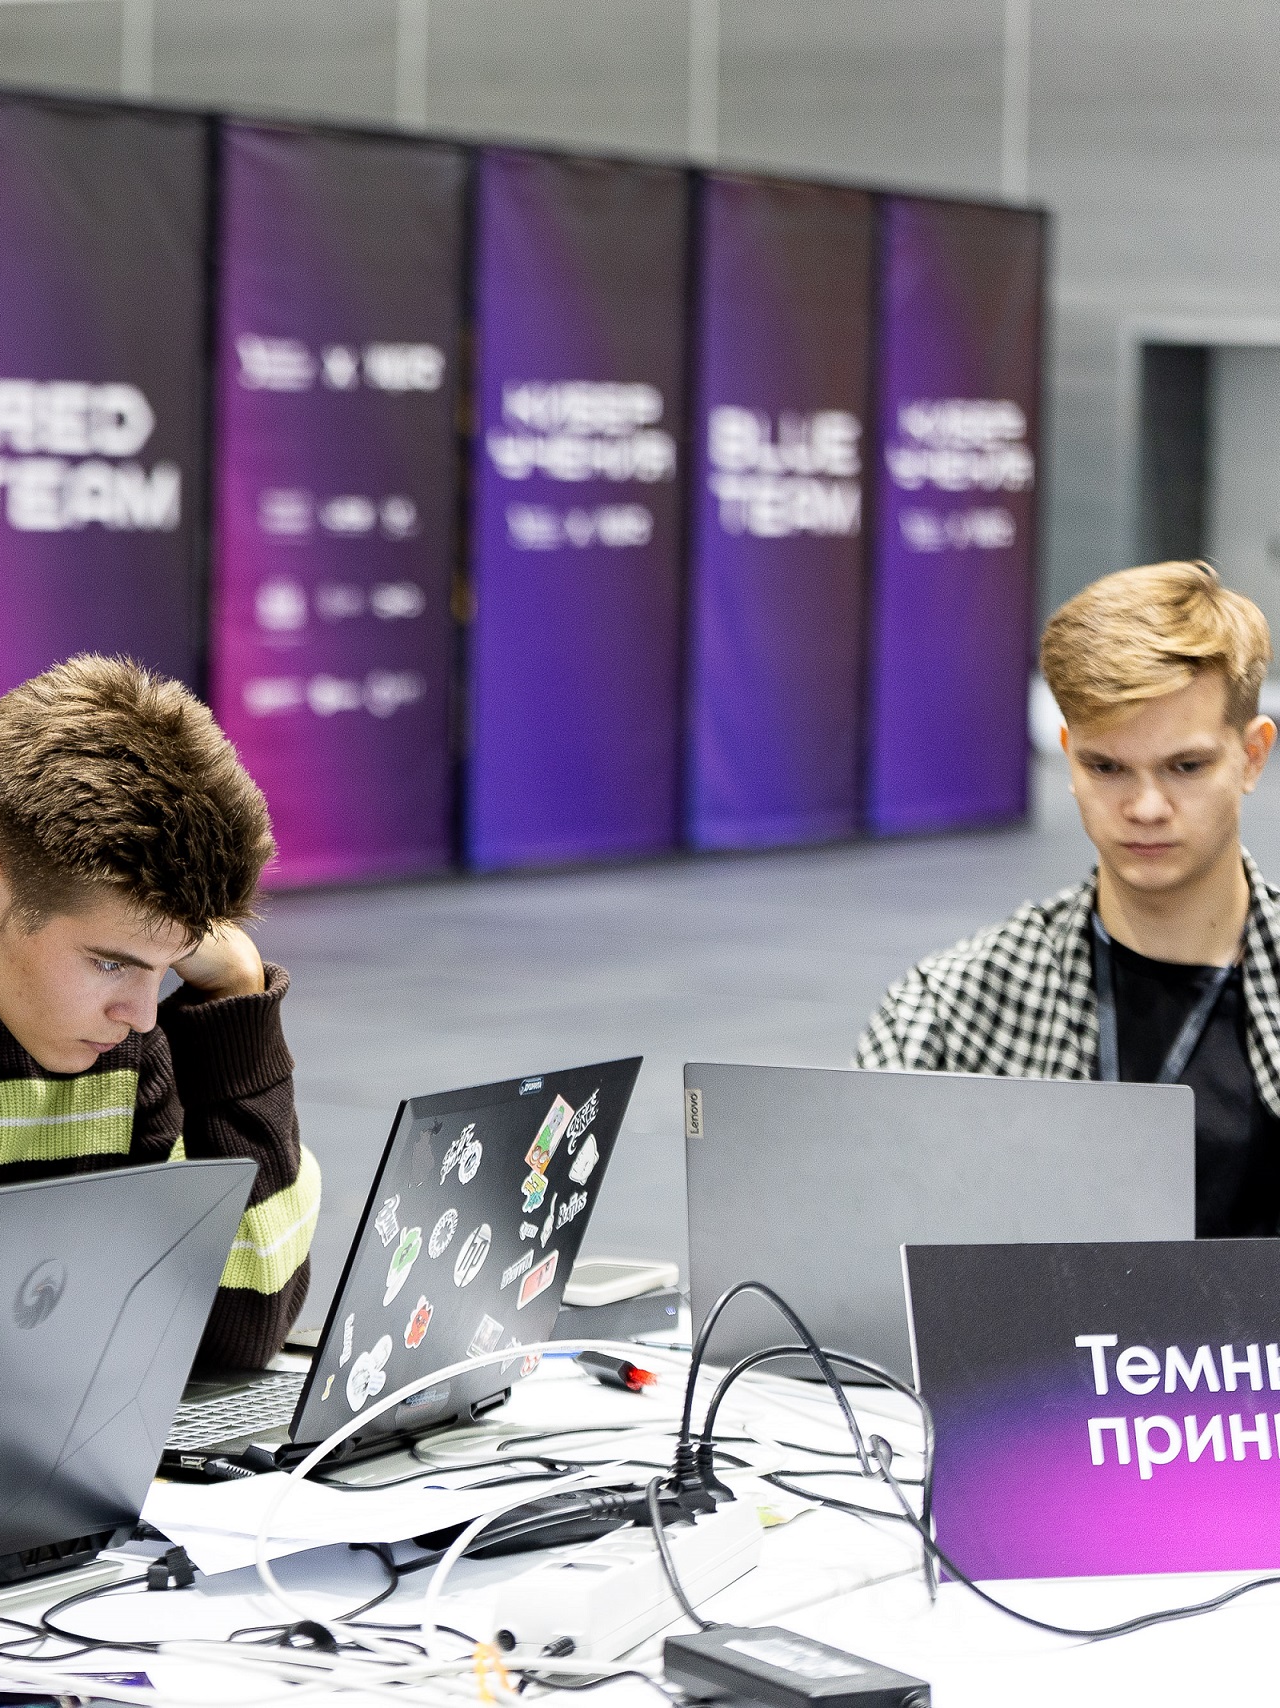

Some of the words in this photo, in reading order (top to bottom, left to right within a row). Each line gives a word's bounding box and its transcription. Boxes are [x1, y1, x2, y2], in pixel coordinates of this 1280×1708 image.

[708, 405, 862, 475] BLUE
[708, 474, 862, 538] TEAM
[690, 1092, 700, 1135] Lenovo
[456, 1225, 490, 1288] hp
[1074, 1333, 1280, 1396] Темн
[1087, 1411, 1280, 1480] прин
